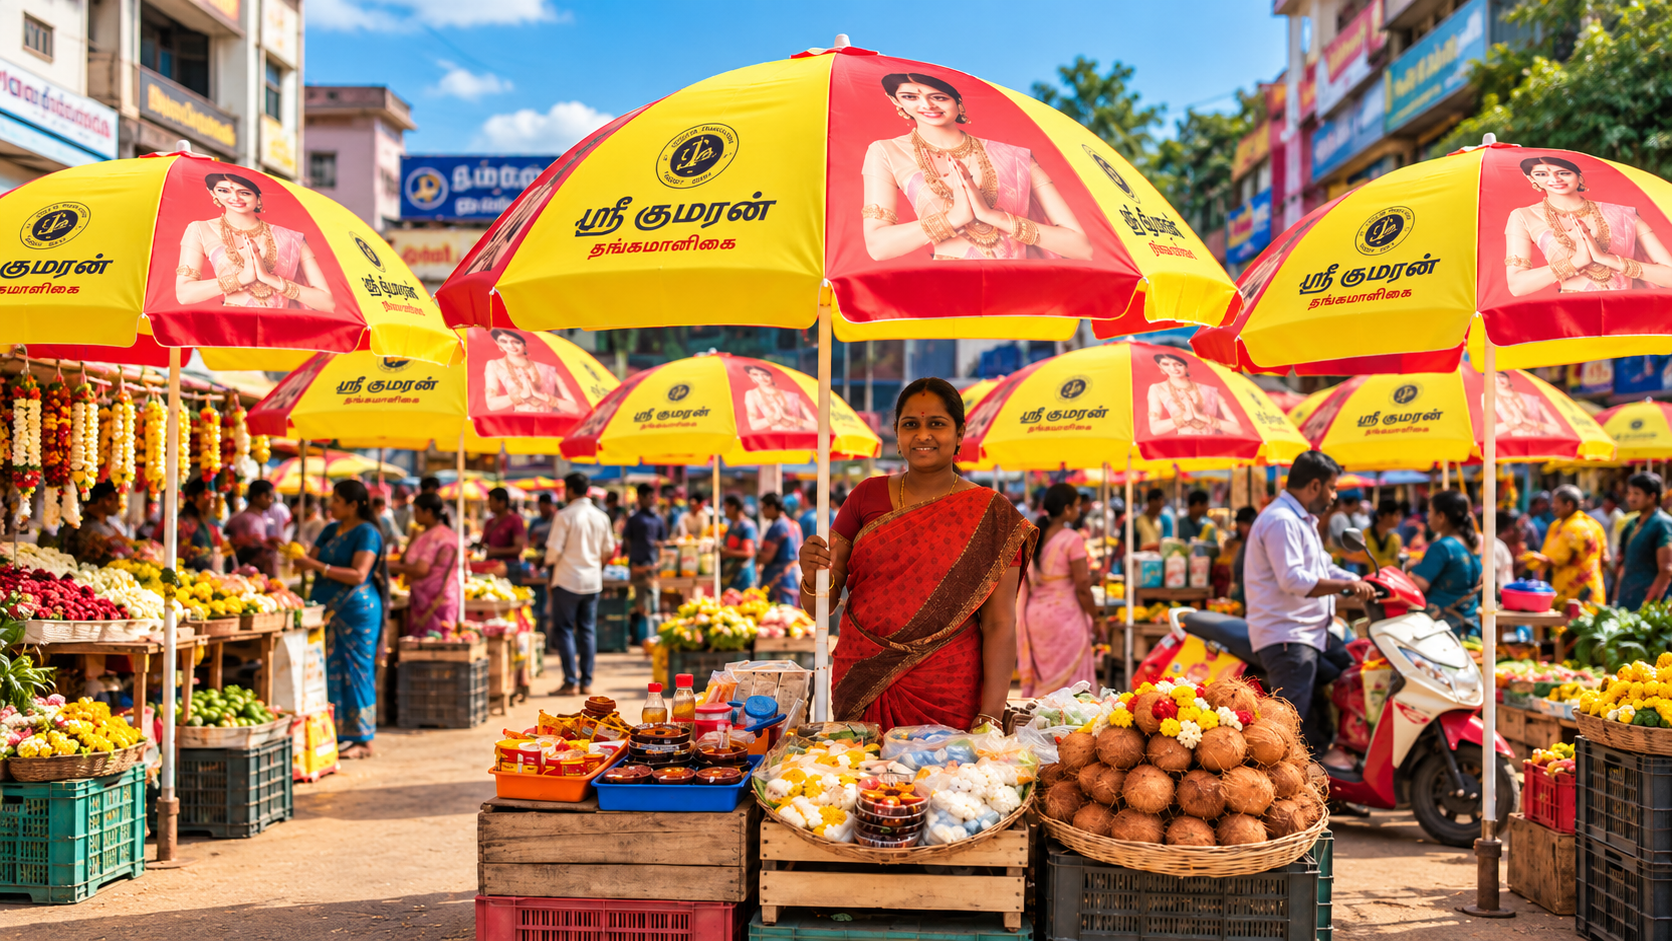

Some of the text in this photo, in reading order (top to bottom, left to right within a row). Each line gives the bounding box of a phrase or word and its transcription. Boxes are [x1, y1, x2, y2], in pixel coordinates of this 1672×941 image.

[575, 191, 777, 237] ஸ்ரீ குமரன்
[0, 253, 113, 279] குமரன்
[1299, 253, 1440, 295] ஸ்ரீ குமரன்
[367, 376, 439, 393] குமரன்
[656, 406, 711, 420] குமரன்
[1046, 405, 1109, 421] குமரன்
[1382, 408, 1443, 425] குமரன்
